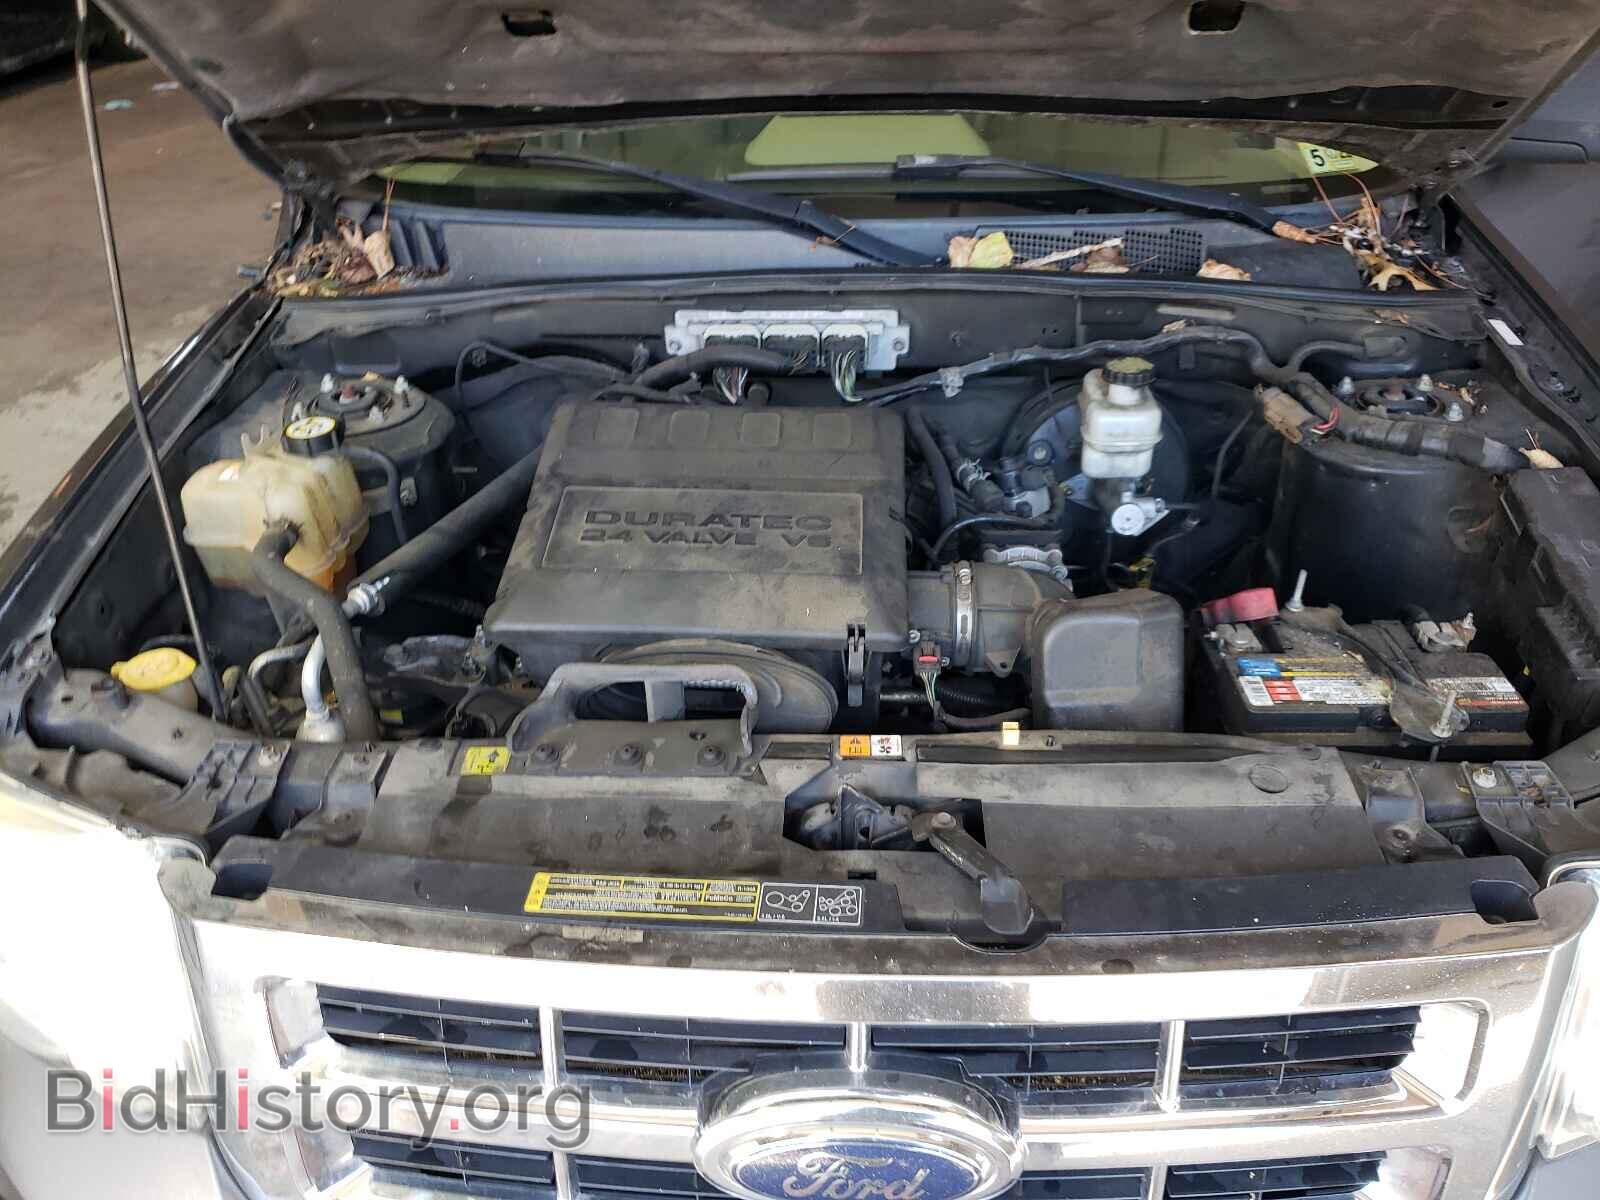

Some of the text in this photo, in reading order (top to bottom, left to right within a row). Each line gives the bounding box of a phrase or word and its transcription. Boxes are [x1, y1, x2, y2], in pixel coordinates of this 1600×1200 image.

[1310, 148, 1325, 167] 5
[584, 510, 832, 531] DURATEC
[579, 529, 633, 544] 24
[644, 530, 756, 547] VALVE
[782, 1151, 930, 1200] Ford
